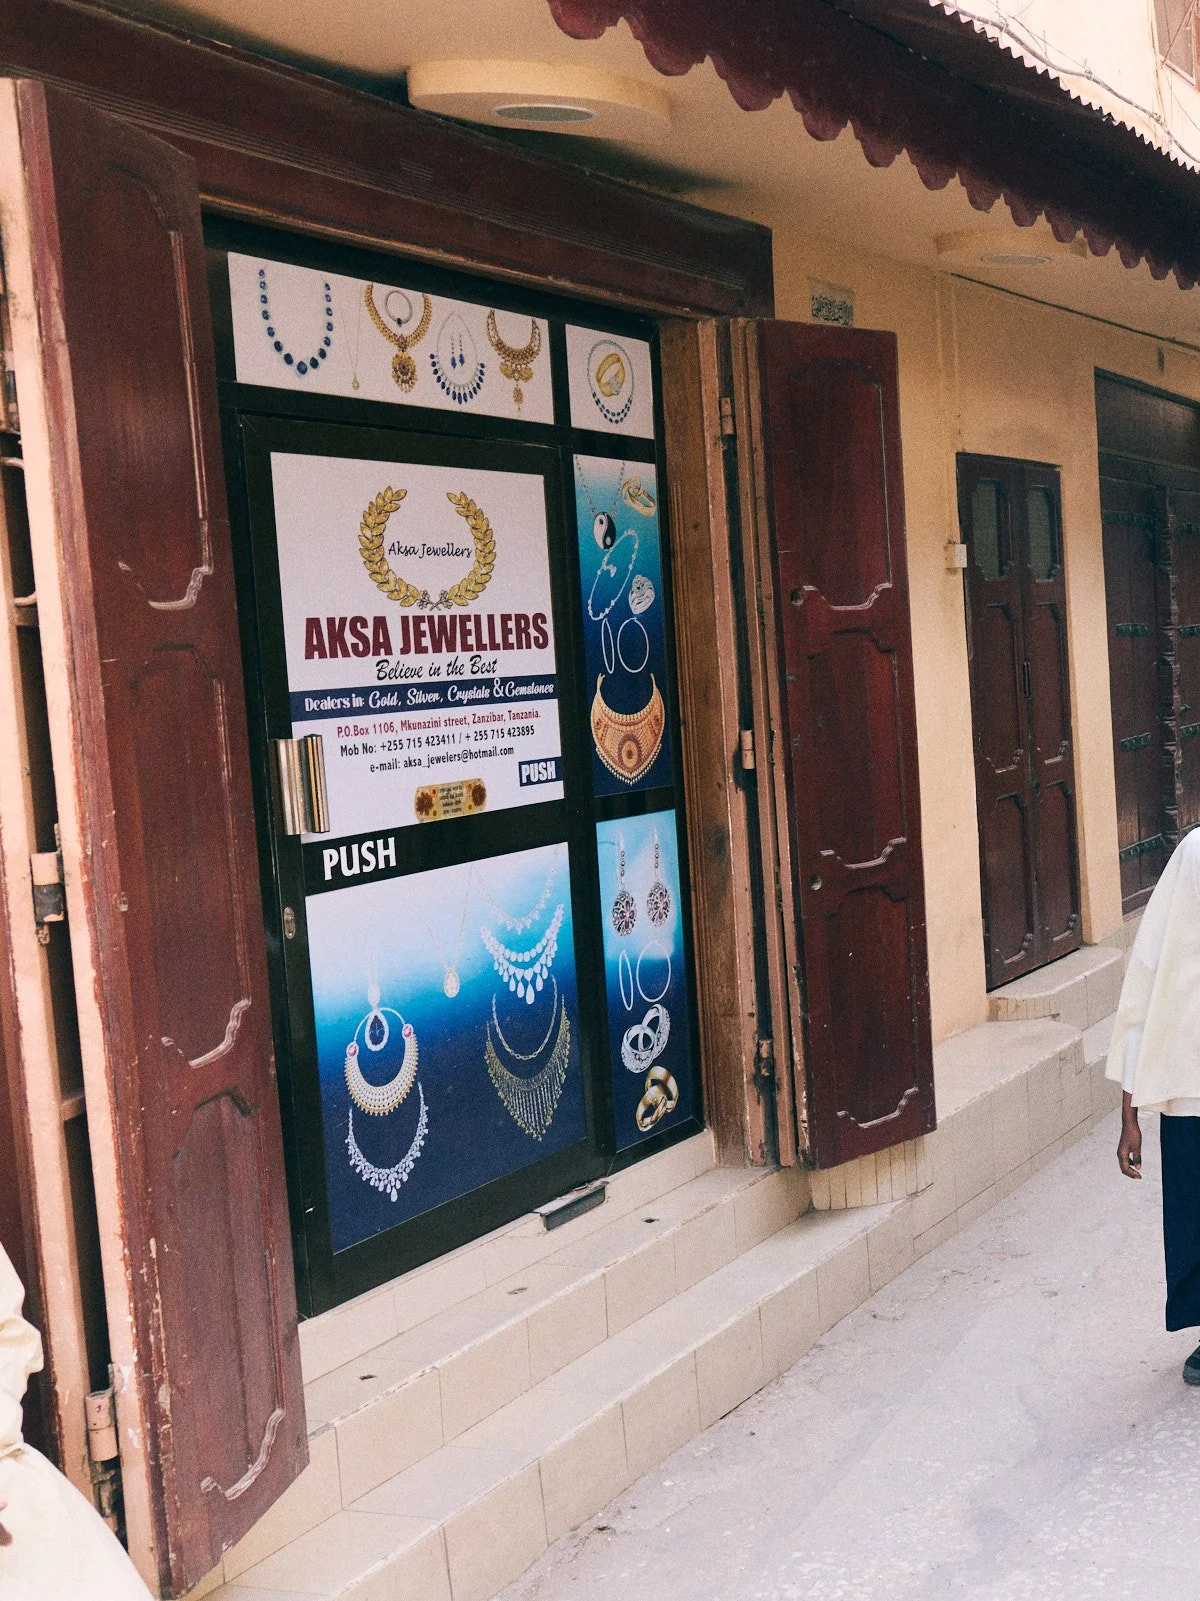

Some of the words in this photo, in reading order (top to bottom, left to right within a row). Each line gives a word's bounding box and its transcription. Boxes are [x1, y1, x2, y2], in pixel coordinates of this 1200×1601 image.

[388, 541, 419, 556] Aksa
[418, 542, 473, 559] Jewellers
[304, 616, 394, 660] AKSA
[400, 613, 549, 655] JEWELLERS
[375, 659, 424, 681] Believe
[428, 662, 442, 678] in
[446, 656, 466, 676] the
[469, 654, 498, 675] Best
[304, 695, 351, 712] Dealers
[368, 691, 402, 709] Gold,
[406, 688, 444, 706] Silver,
[447, 685, 491, 704] Crystals
[493, 677, 504, 698] &
[505, 681, 554, 698] Gemstones
[337, 725, 370, 738] P.O.Box
[373, 721, 398, 736] 1106,
[400, 717, 442, 732] Mkunazini
[443, 715, 470, 728] street,
[472, 711, 506, 724] Zanzibar,
[508, 708, 541, 721] Tanzania.
[340, 744, 359, 757] Mob
[362, 742, 377, 755] No:
[380, 738, 404, 752] +255
[407, 736, 422, 750] 715
[425, 733, 455, 747] 423411
[474, 730, 488, 742] 255
[491, 728, 505, 740] 715
[507, 725, 535, 738] 423895
[370, 758, 401, 772] e-mail:
[403, 746, 515, 769] aksa_jewelers@hotmail.com
[521, 761, 556, 784] PUSH
[323, 837, 397, 880] PUSH
